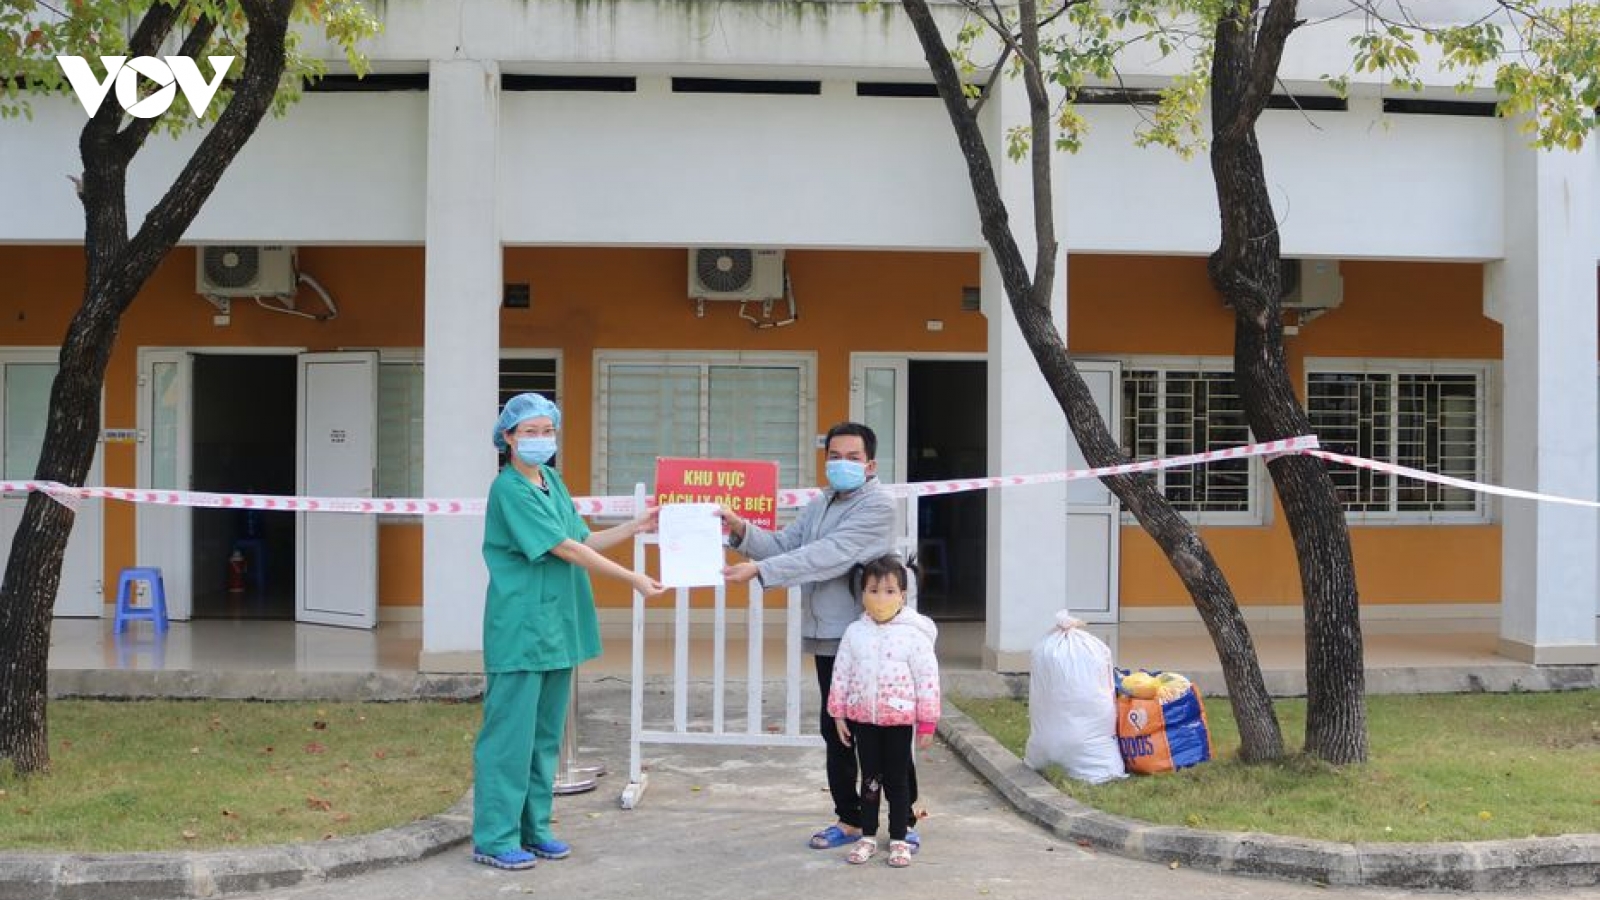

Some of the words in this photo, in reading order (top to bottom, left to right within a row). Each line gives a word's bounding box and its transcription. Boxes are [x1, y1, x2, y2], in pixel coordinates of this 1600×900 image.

[684, 469, 713, 486] KHU
[716, 470, 745, 491] VỰC
[744, 494, 774, 514] BIỆT
